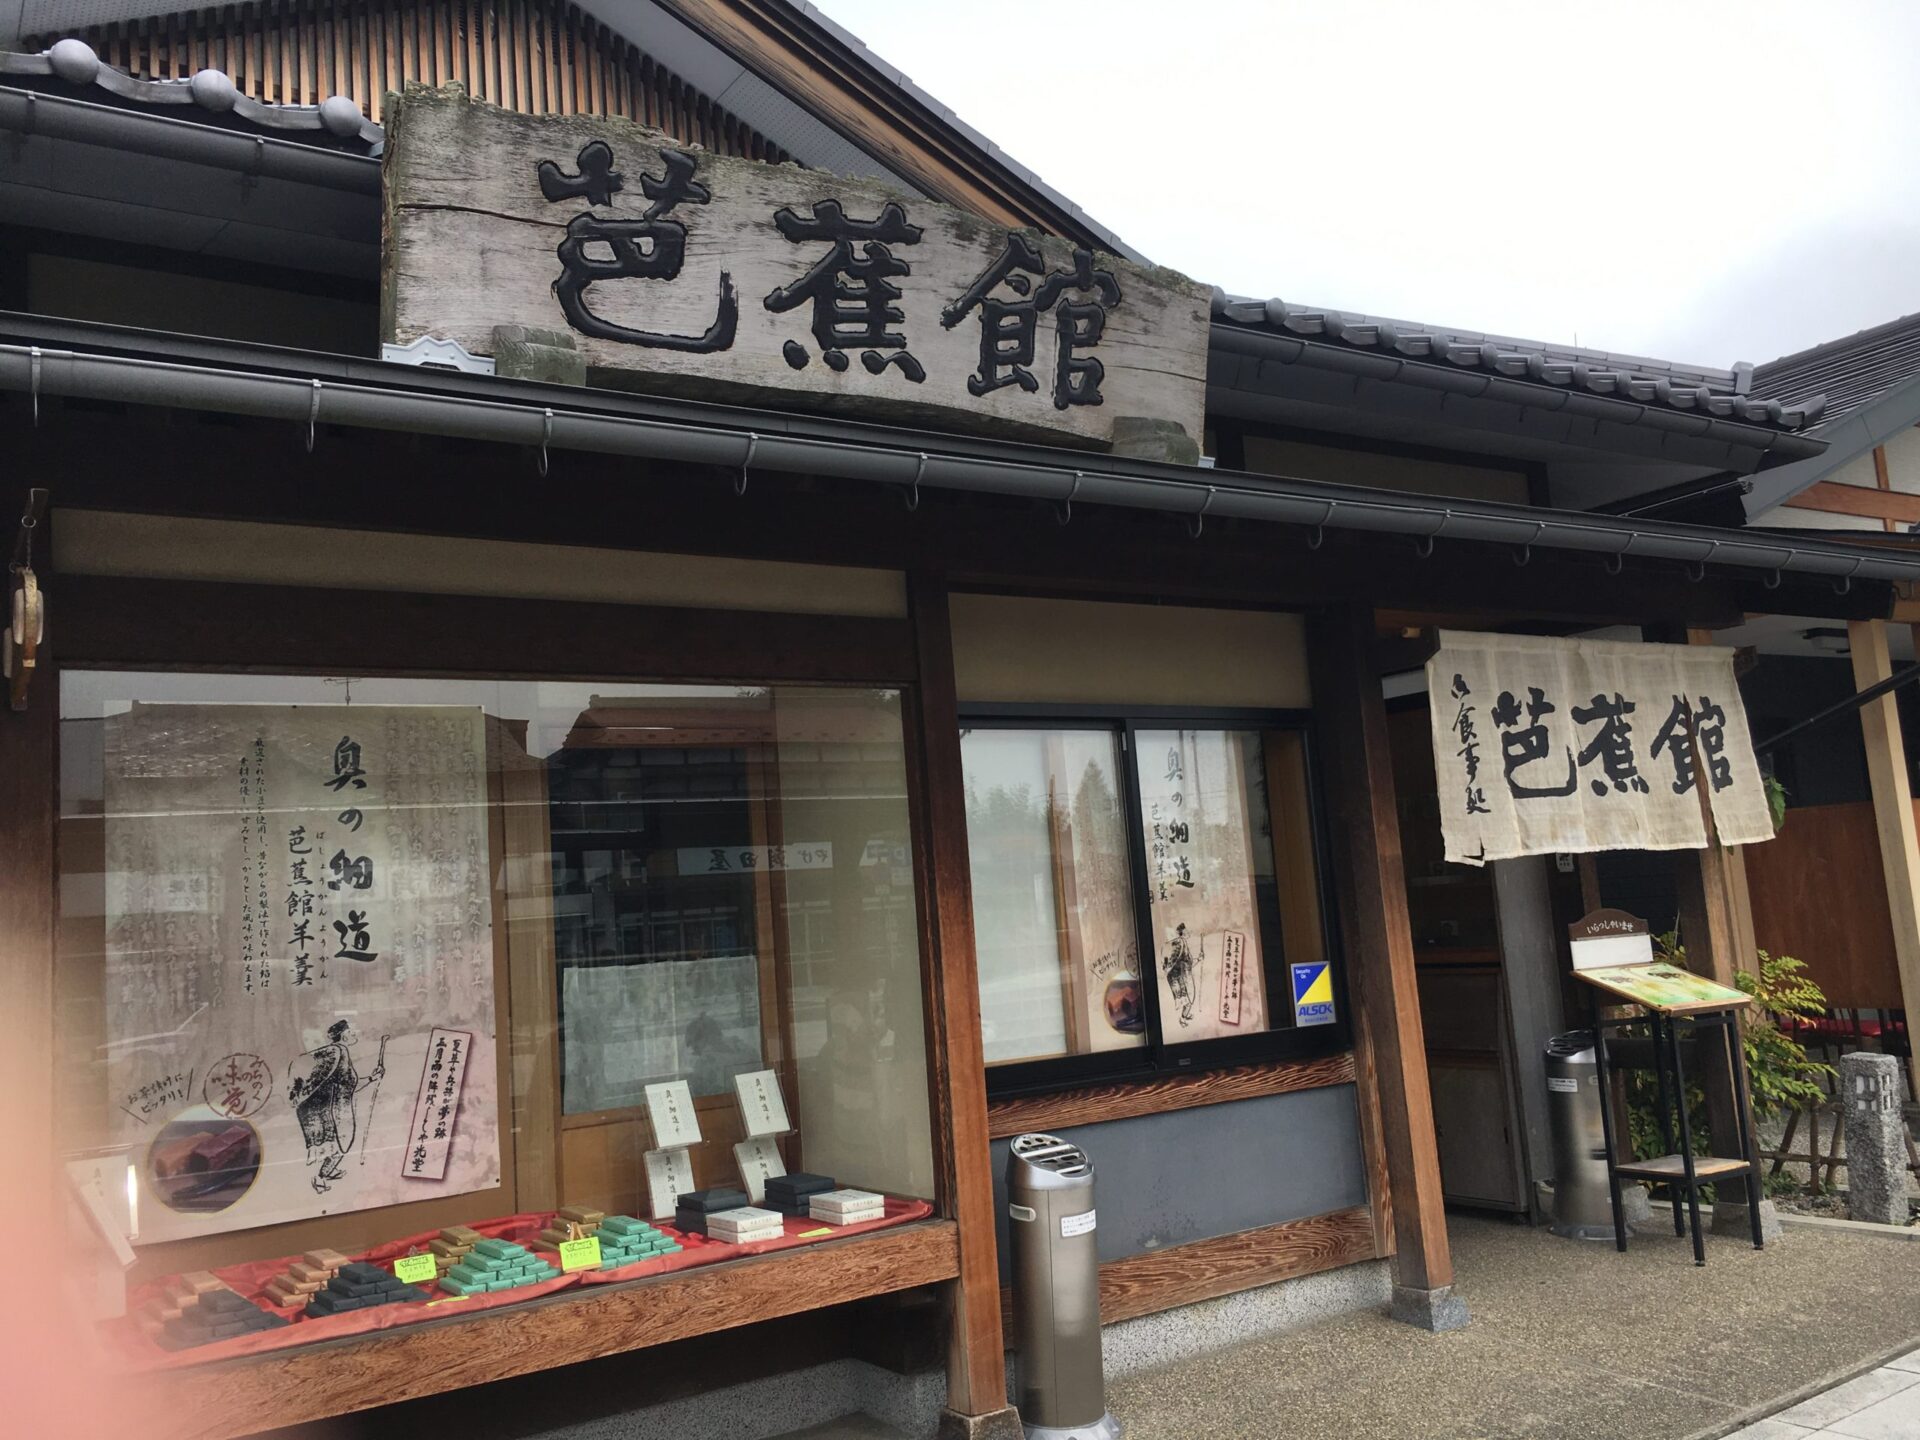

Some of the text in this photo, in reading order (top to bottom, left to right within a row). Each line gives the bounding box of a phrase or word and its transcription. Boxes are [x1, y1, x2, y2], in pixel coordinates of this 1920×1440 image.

[537, 140, 1122, 410] 芭蕉館
[1164, 747, 1195, 889] 奥の細道
[1491, 686, 1734, 799] 芭蕉館
[284, 826, 315, 986] 芭蕉館羊羹
[324, 735, 379, 963] 奥の細道
[1298, 1005, 1333, 1016] ALSOK
